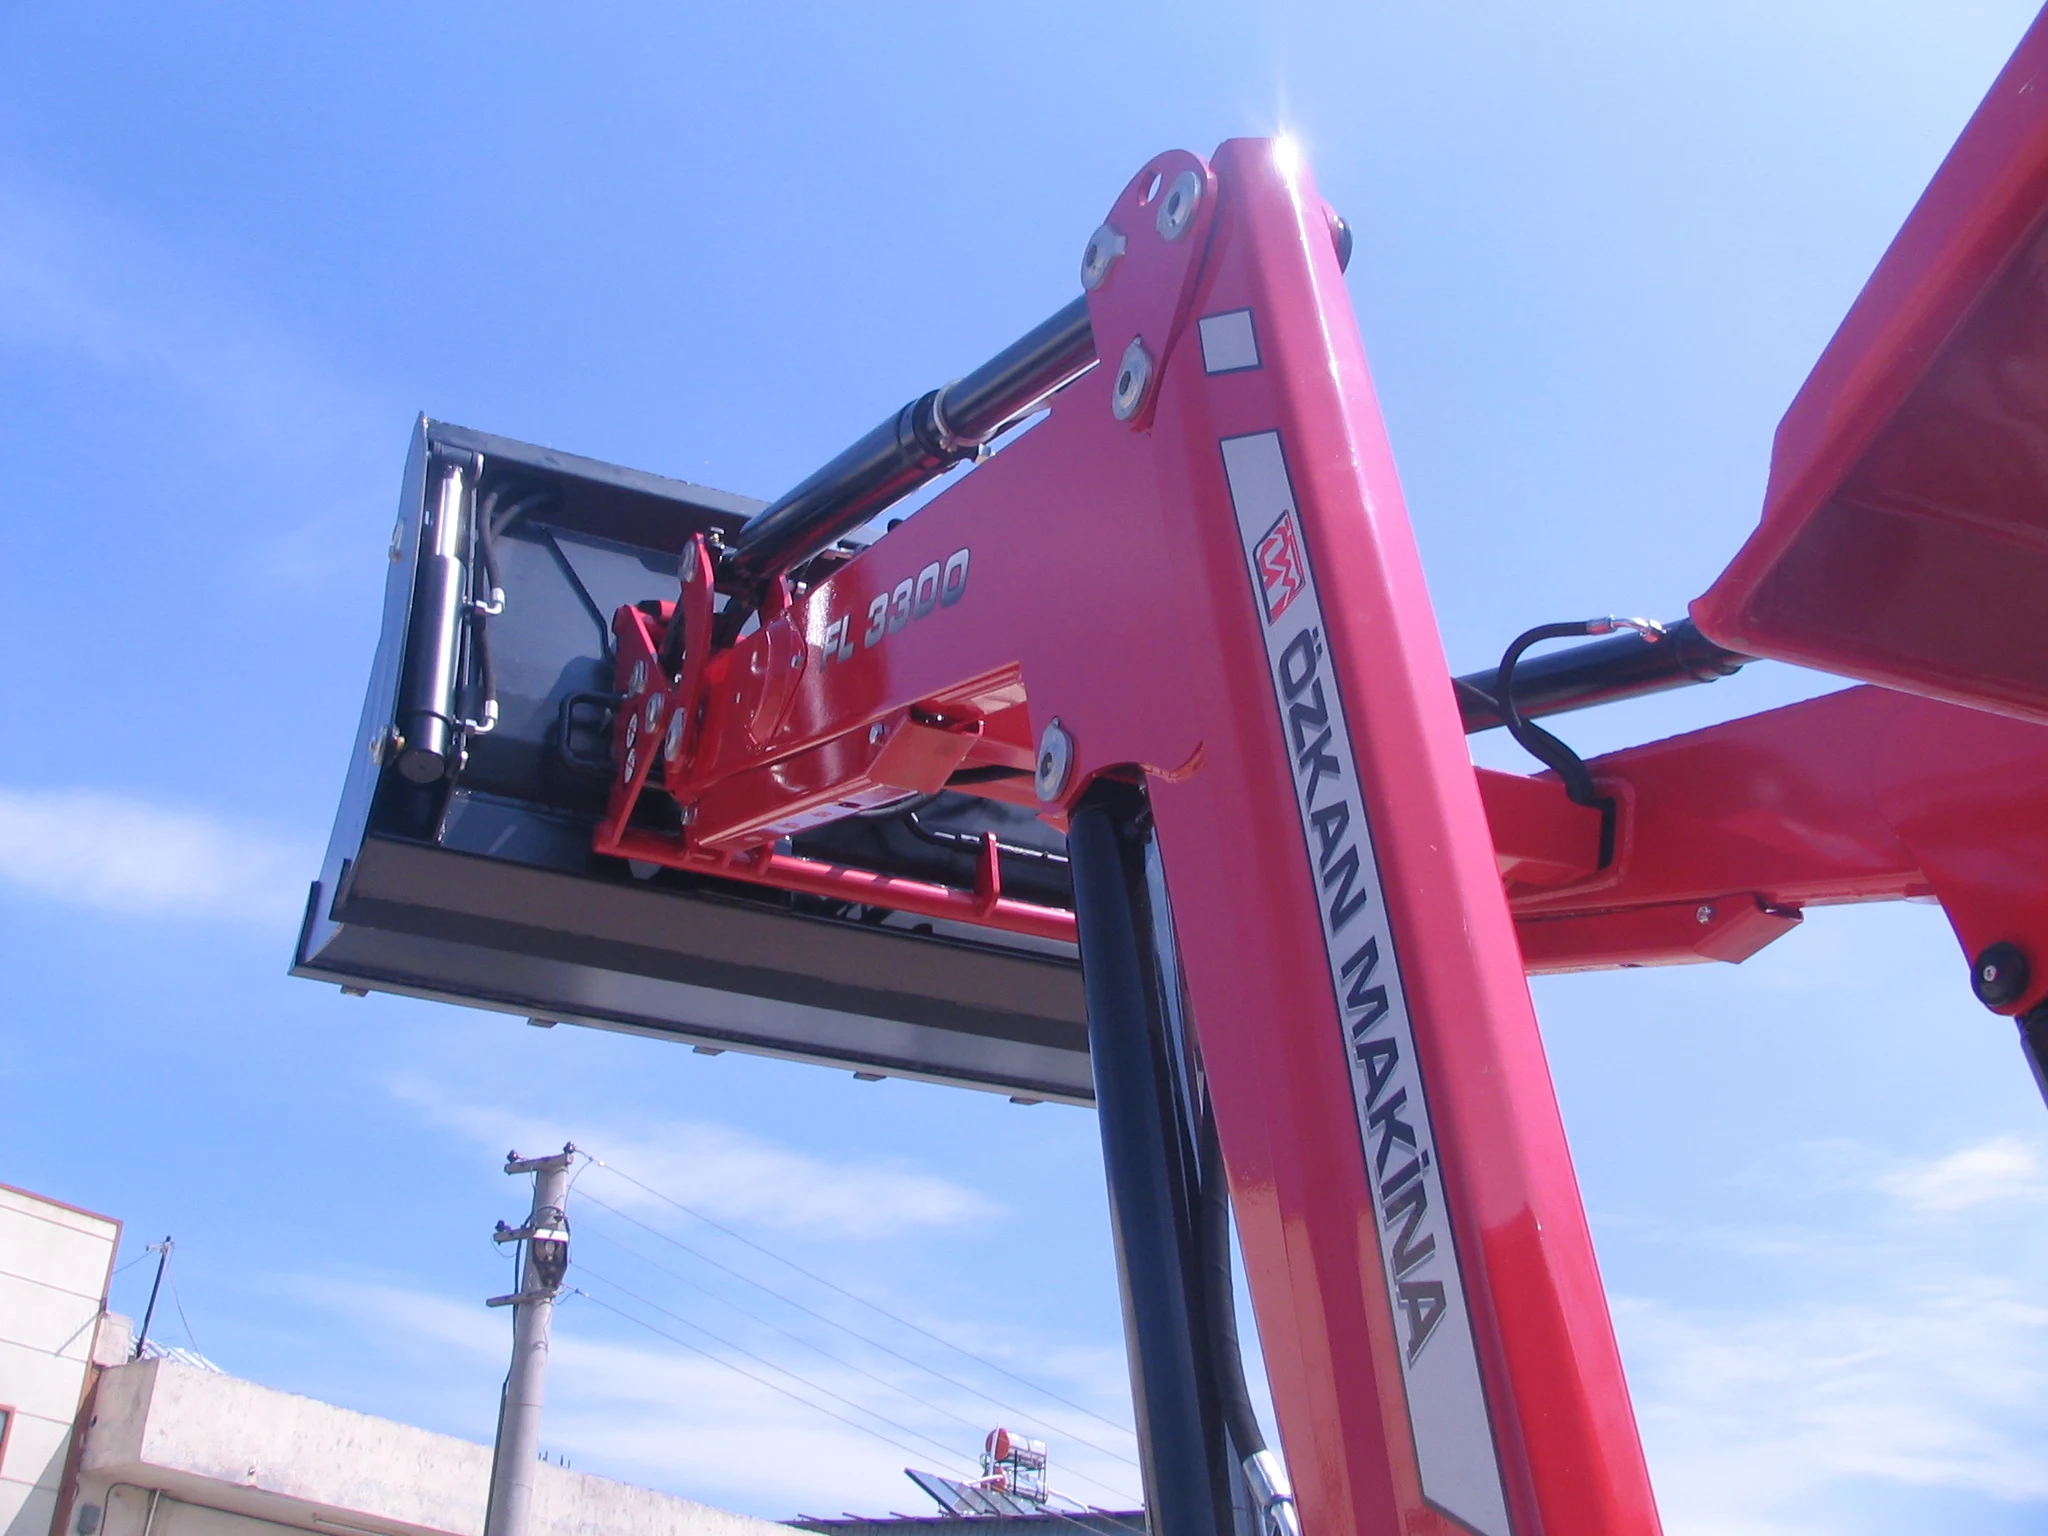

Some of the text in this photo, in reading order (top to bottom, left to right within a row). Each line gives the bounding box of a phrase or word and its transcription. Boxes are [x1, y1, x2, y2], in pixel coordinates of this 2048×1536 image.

[819, 546, 970, 674] FL 3300
[1278, 626, 1367, 936] ÖZKAN
[1340, 934, 1447, 1369] MAKİNA
